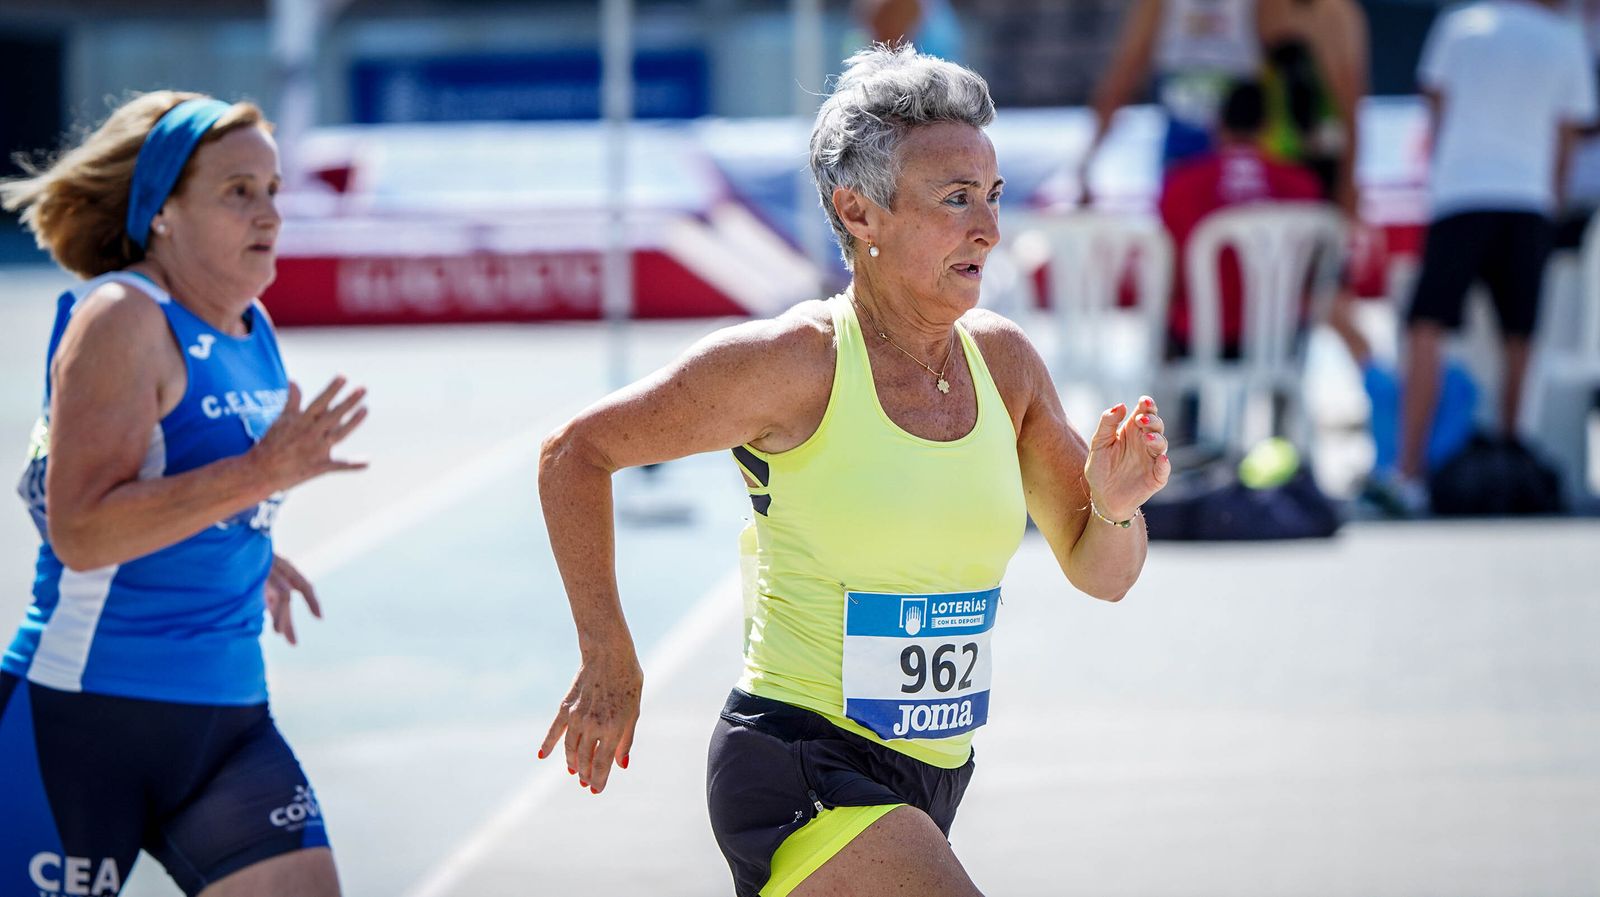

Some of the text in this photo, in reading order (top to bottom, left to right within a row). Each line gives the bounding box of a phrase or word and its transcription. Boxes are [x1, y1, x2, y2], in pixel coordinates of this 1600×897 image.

[931, 597, 987, 615] LOTERÍAS
[900, 642, 979, 694] 962
[28, 851, 120, 895] CEA
